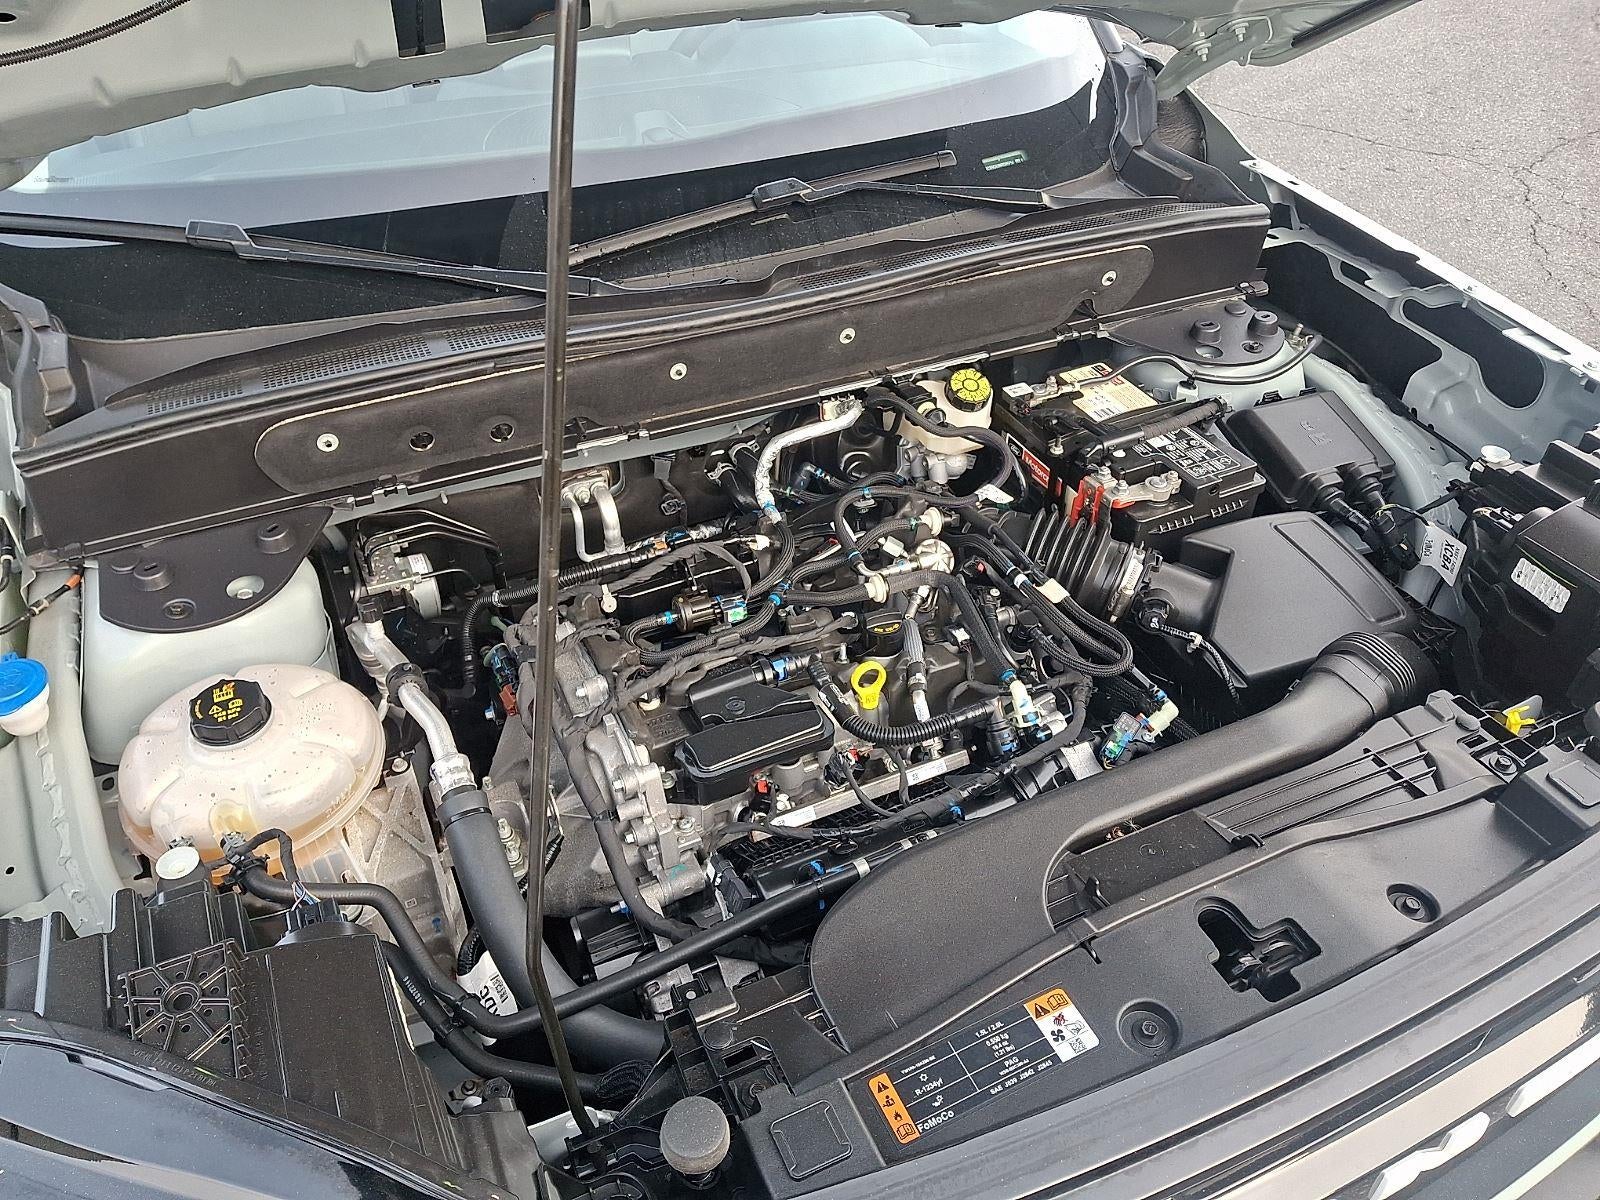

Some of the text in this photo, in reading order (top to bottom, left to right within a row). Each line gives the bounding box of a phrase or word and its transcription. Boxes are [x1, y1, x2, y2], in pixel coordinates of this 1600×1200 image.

[1440, 539, 1456, 572] XCBA
[1004, 1056, 1019, 1067] PAG
[915, 1078, 943, 1097] R-1234yf
[990, 1086, 1003, 1094] SAE
[916, 1110, 954, 1133] FoMoCo
